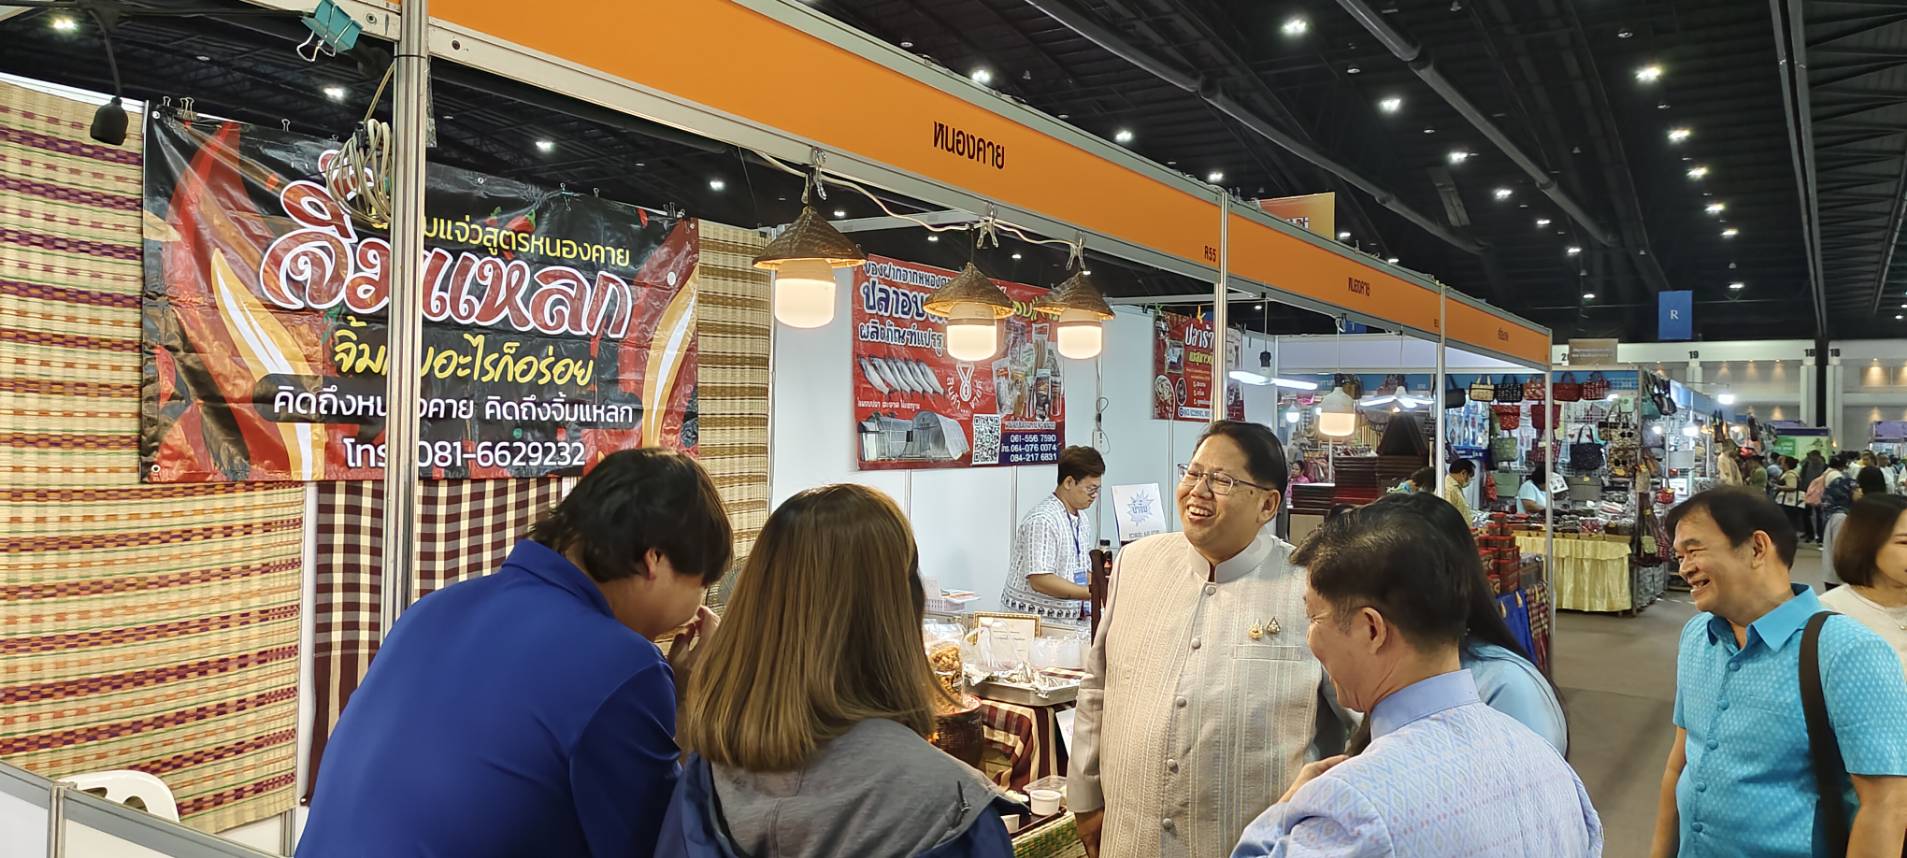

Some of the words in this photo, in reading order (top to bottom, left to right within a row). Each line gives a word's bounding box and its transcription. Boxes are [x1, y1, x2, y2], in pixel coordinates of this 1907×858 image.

[933, 121, 1006, 170] หนองคาย
[1670, 309, 1679, 320] R
[333, 315, 595, 387] จิ้มอะไรก็อร่อย
[859, 319, 945, 357] ผลิตภัณฑ์แปรรู
[1688, 350, 1699, 359] 19
[1561, 353, 1569, 362] 2
[273, 385, 474, 422] คิดถึงหนคาย
[484, 389, 633, 424] คิดถึงจิ้มแหลก
[418, 440, 586, 468] 081-6629232
